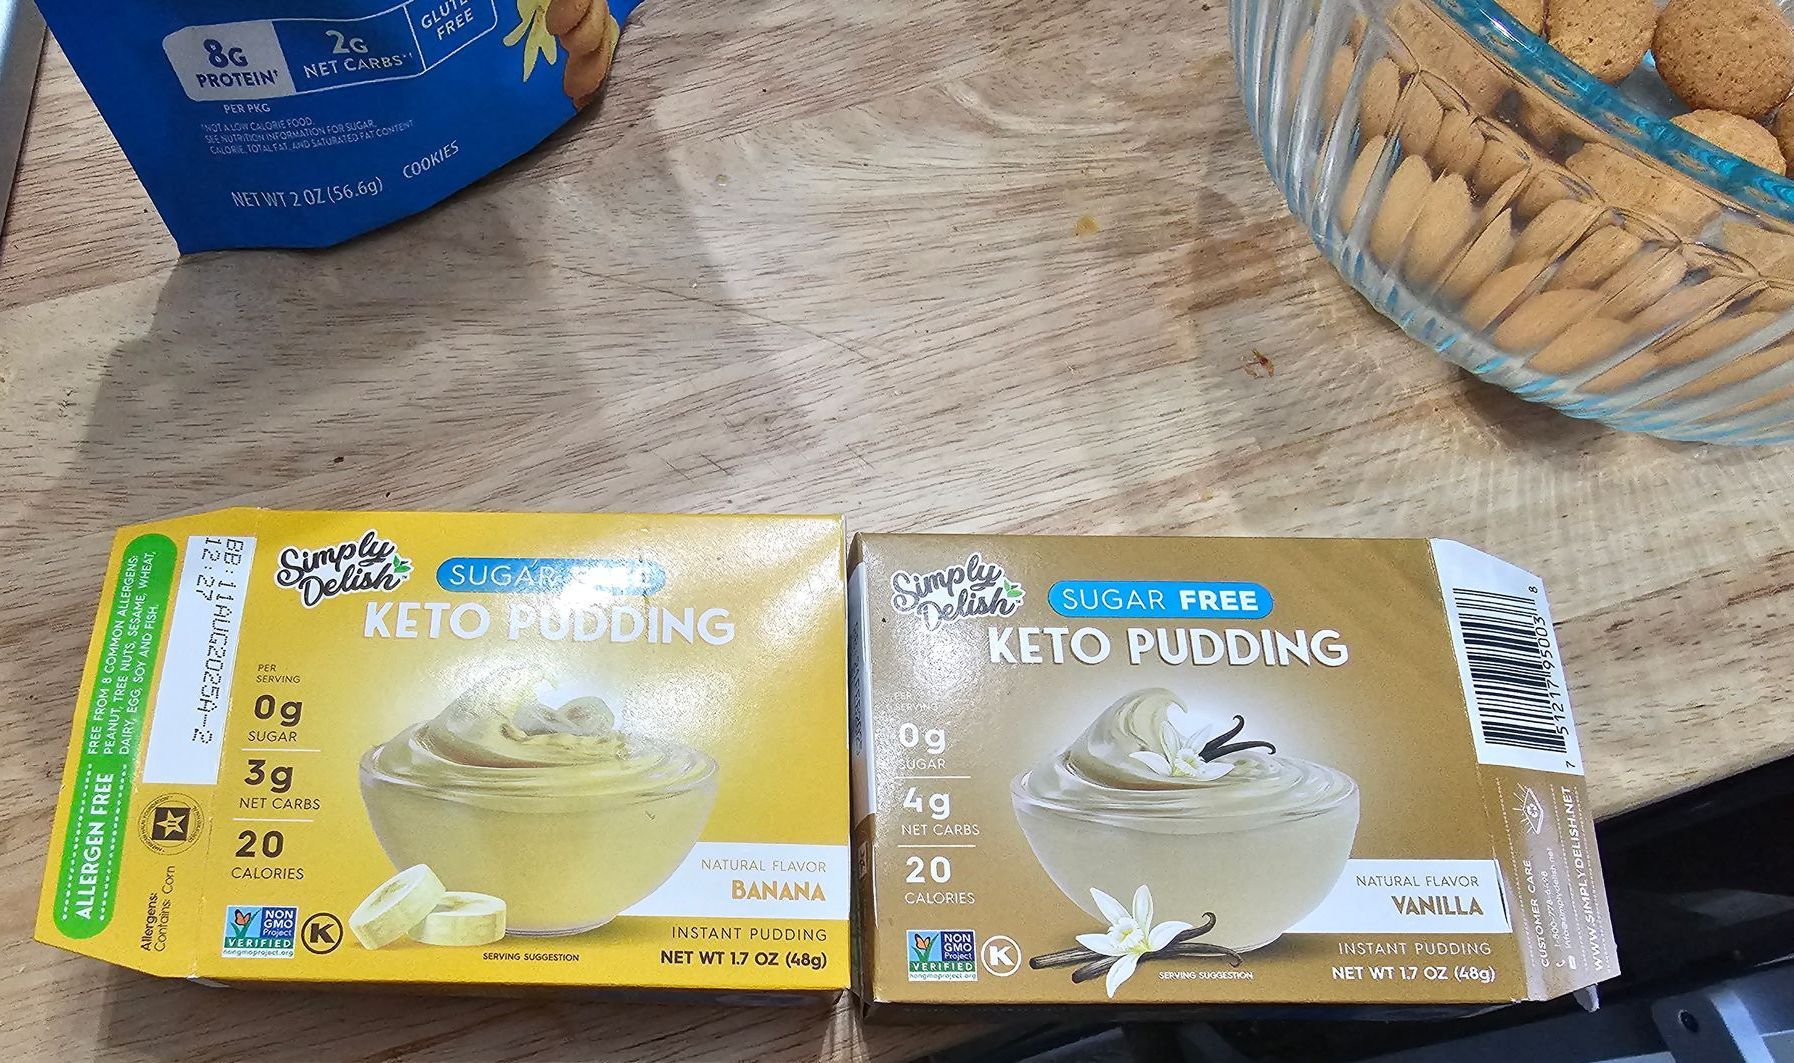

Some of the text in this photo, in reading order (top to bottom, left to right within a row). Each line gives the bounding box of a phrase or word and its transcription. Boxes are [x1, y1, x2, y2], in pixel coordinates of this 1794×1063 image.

[437, 8, 473, 40] FREE
[325, 30, 368, 54] 2G
[203, 39, 248, 68] 8G
[303, 60, 338, 79] NET
[224, 103, 271, 114] PER PKG
[204, 135, 219, 144] SEE
[221, 132, 265, 144] NUTRITION
[265, 127, 325, 142] INFORMATION
[327, 124, 345, 134] FOR
[248, 142, 273, 153] TOTAL
[292, 138, 310, 149] AND
[312, 133, 359, 148] SATURATED
[359, 129, 375, 140] FAT
[376, 119, 414, 138] CONTENT
[250, 119, 286, 131] CALORIE
[402, 141, 460, 179] COOKIES
[231, 176, 383, 207] NET WT 2 OZ (56.6g)
[196, 537, 222, 601] 12:27
[277, 529, 392, 587] Simply
[119, 555, 139, 617] ALLERGENS:
[302, 562, 401, 606] Delish
[449, 564, 556, 588] SUGAR
[892, 552, 1002, 612] Simply
[1062, 588, 1259, 611] SUGAR FREE
[1528, 586, 1538, 594] 8
[920, 588, 1017, 632] Delish
[364, 602, 735, 645] KETO PUDDING
[103, 551, 157, 754] PEANUT, TREE NUTS, SESAME, WHEAT,
[104, 621, 123, 674] COMMON
[988, 627, 1350, 668] KETO PUDDING
[257, 663, 276, 672] PER
[119, 604, 159, 755] DAIRY, EGG, SOY AND FISH.
[256, 674, 301, 684] SERVING
[94, 690, 108, 721] FROM
[254, 694, 302, 727] 0g
[88, 724, 102, 754] FREE
[248, 730, 297, 742] SUGAR
[900, 722, 946, 754] 0g
[898, 758, 946, 771] SUGAR
[1566, 760, 1575, 768] 7
[244, 759, 293, 793] 3g
[239, 797, 320, 810] NET CARBS
[902, 787, 951, 820] 4g
[901, 824, 980, 836] NET CARBS
[75, 773, 114, 920] ALLERGEN FREE
[235, 830, 283, 858] 20
[231, 866, 304, 880] CALORIES
[701, 859, 827, 873] NATURAL FLAVOR
[904, 856, 951, 884] 20
[1356, 875, 1479, 887] NATURAL FLAVOR
[1561, 786, 1603, 971] WWW.SIMPLYDELISH.NET
[731, 880, 826, 902] BANANA
[904, 892, 975, 905] CALORIES
[154, 865, 175, 952] Contains: Corn
[265, 910, 293, 919] NON
[1391, 895, 1484, 916] VANILLA
[1523, 859, 1550, 968] CUSTOMER CARE
[140, 891, 158, 951] Allergens:
[264, 919, 293, 929] GMO
[228, 938, 291, 948] VERIFIED
[263, 929, 292, 938] Project
[671, 926, 827, 942] INSTANT PUDDING
[944, 933, 971, 943] NON
[483, 952, 579, 962] SERVING SUGGESTION
[944, 943, 972, 952] GMO
[944, 952, 972, 961] Project
[1339, 942, 1491, 955] INSTANT PUDDING
[660, 950, 827, 969] NET WT 1.7 OZ (48g)
[913, 962, 973, 971] VERIFIED
[1159, 971, 1253, 980] SERVING SUGGESTION
[1332, 966, 1495, 983] NET WT 1.7 OZ (48g)
